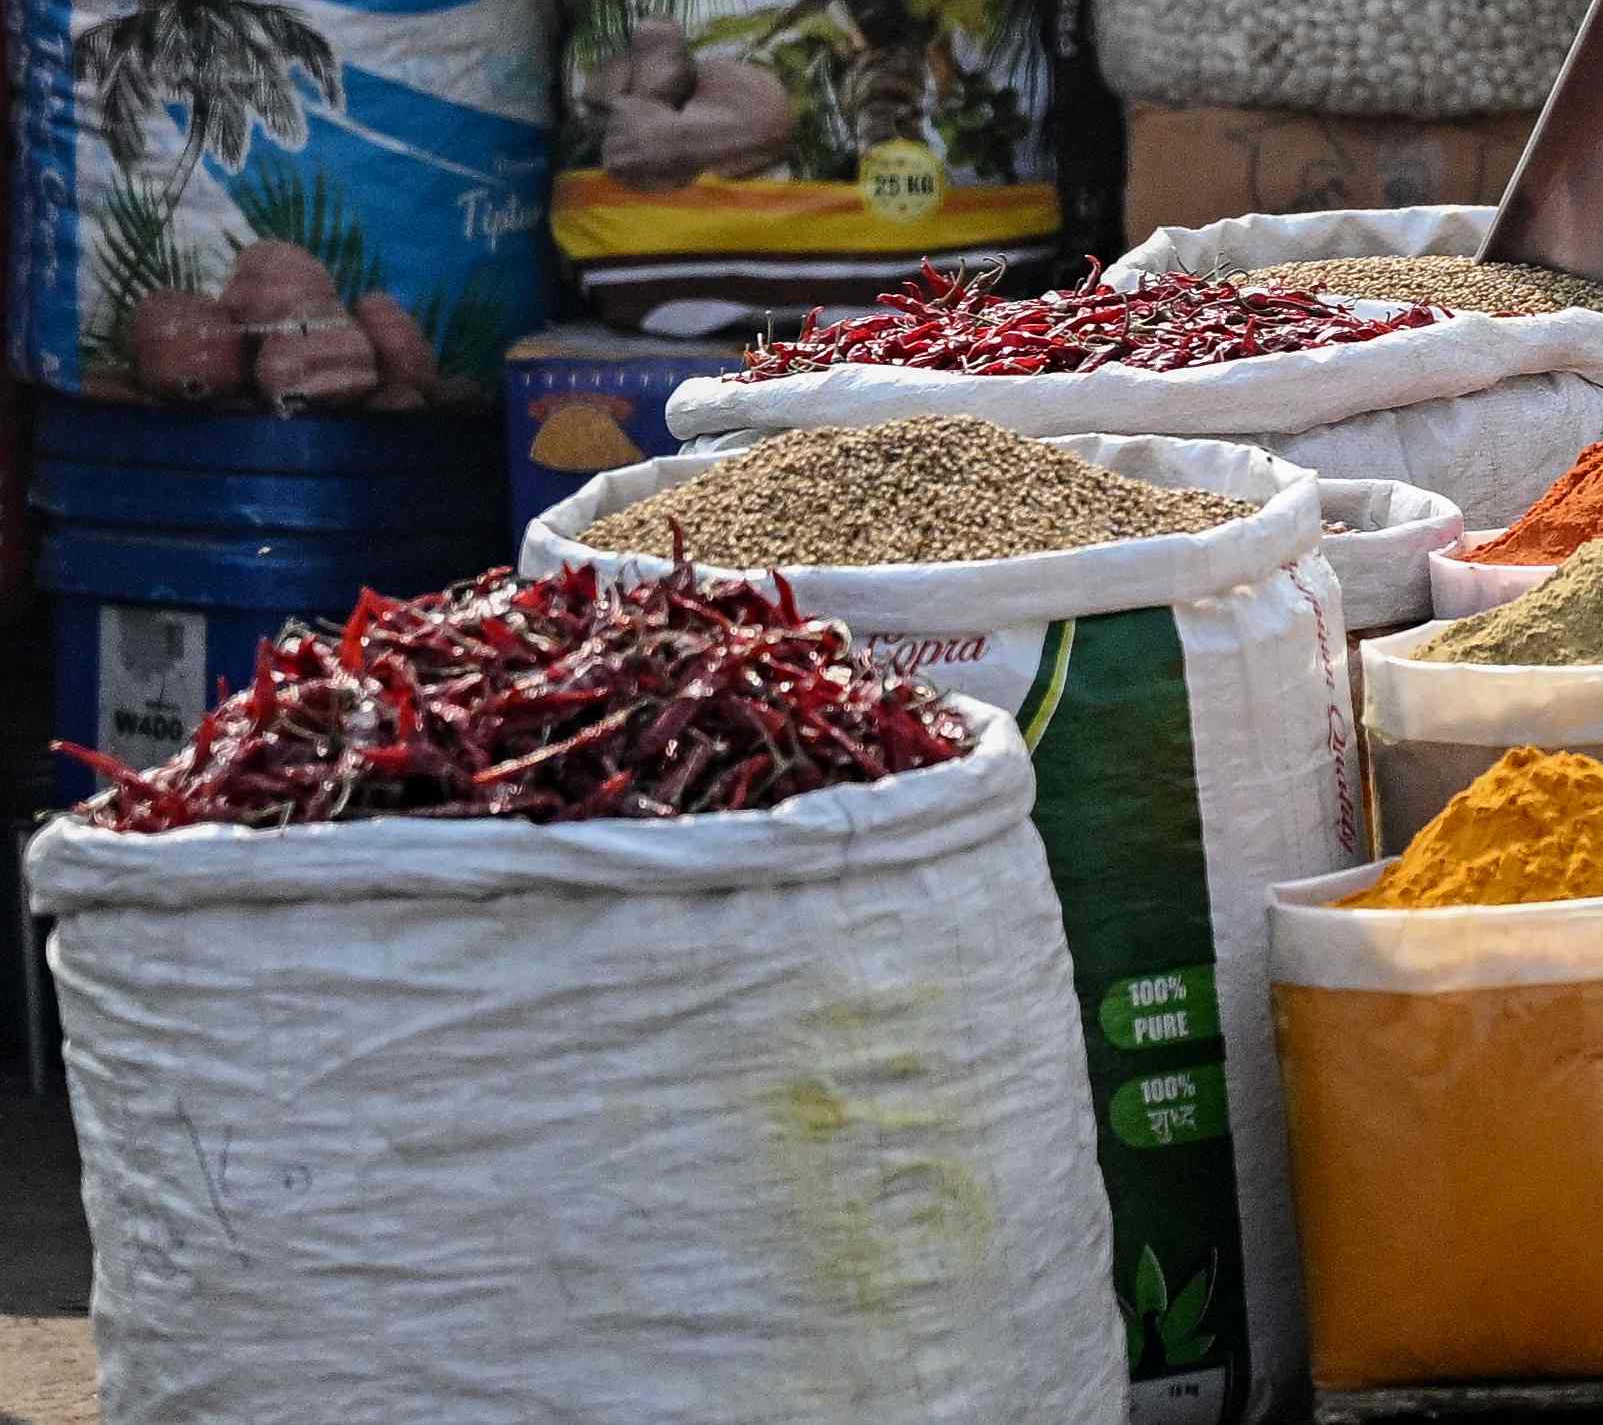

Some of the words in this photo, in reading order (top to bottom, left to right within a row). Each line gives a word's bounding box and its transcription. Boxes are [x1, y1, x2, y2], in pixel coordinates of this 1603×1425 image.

[1128, 974, 1188, 1008] 100%
[1134, 1010, 1190, 1047] PURE
[1140, 1071, 1196, 1105] 100%
